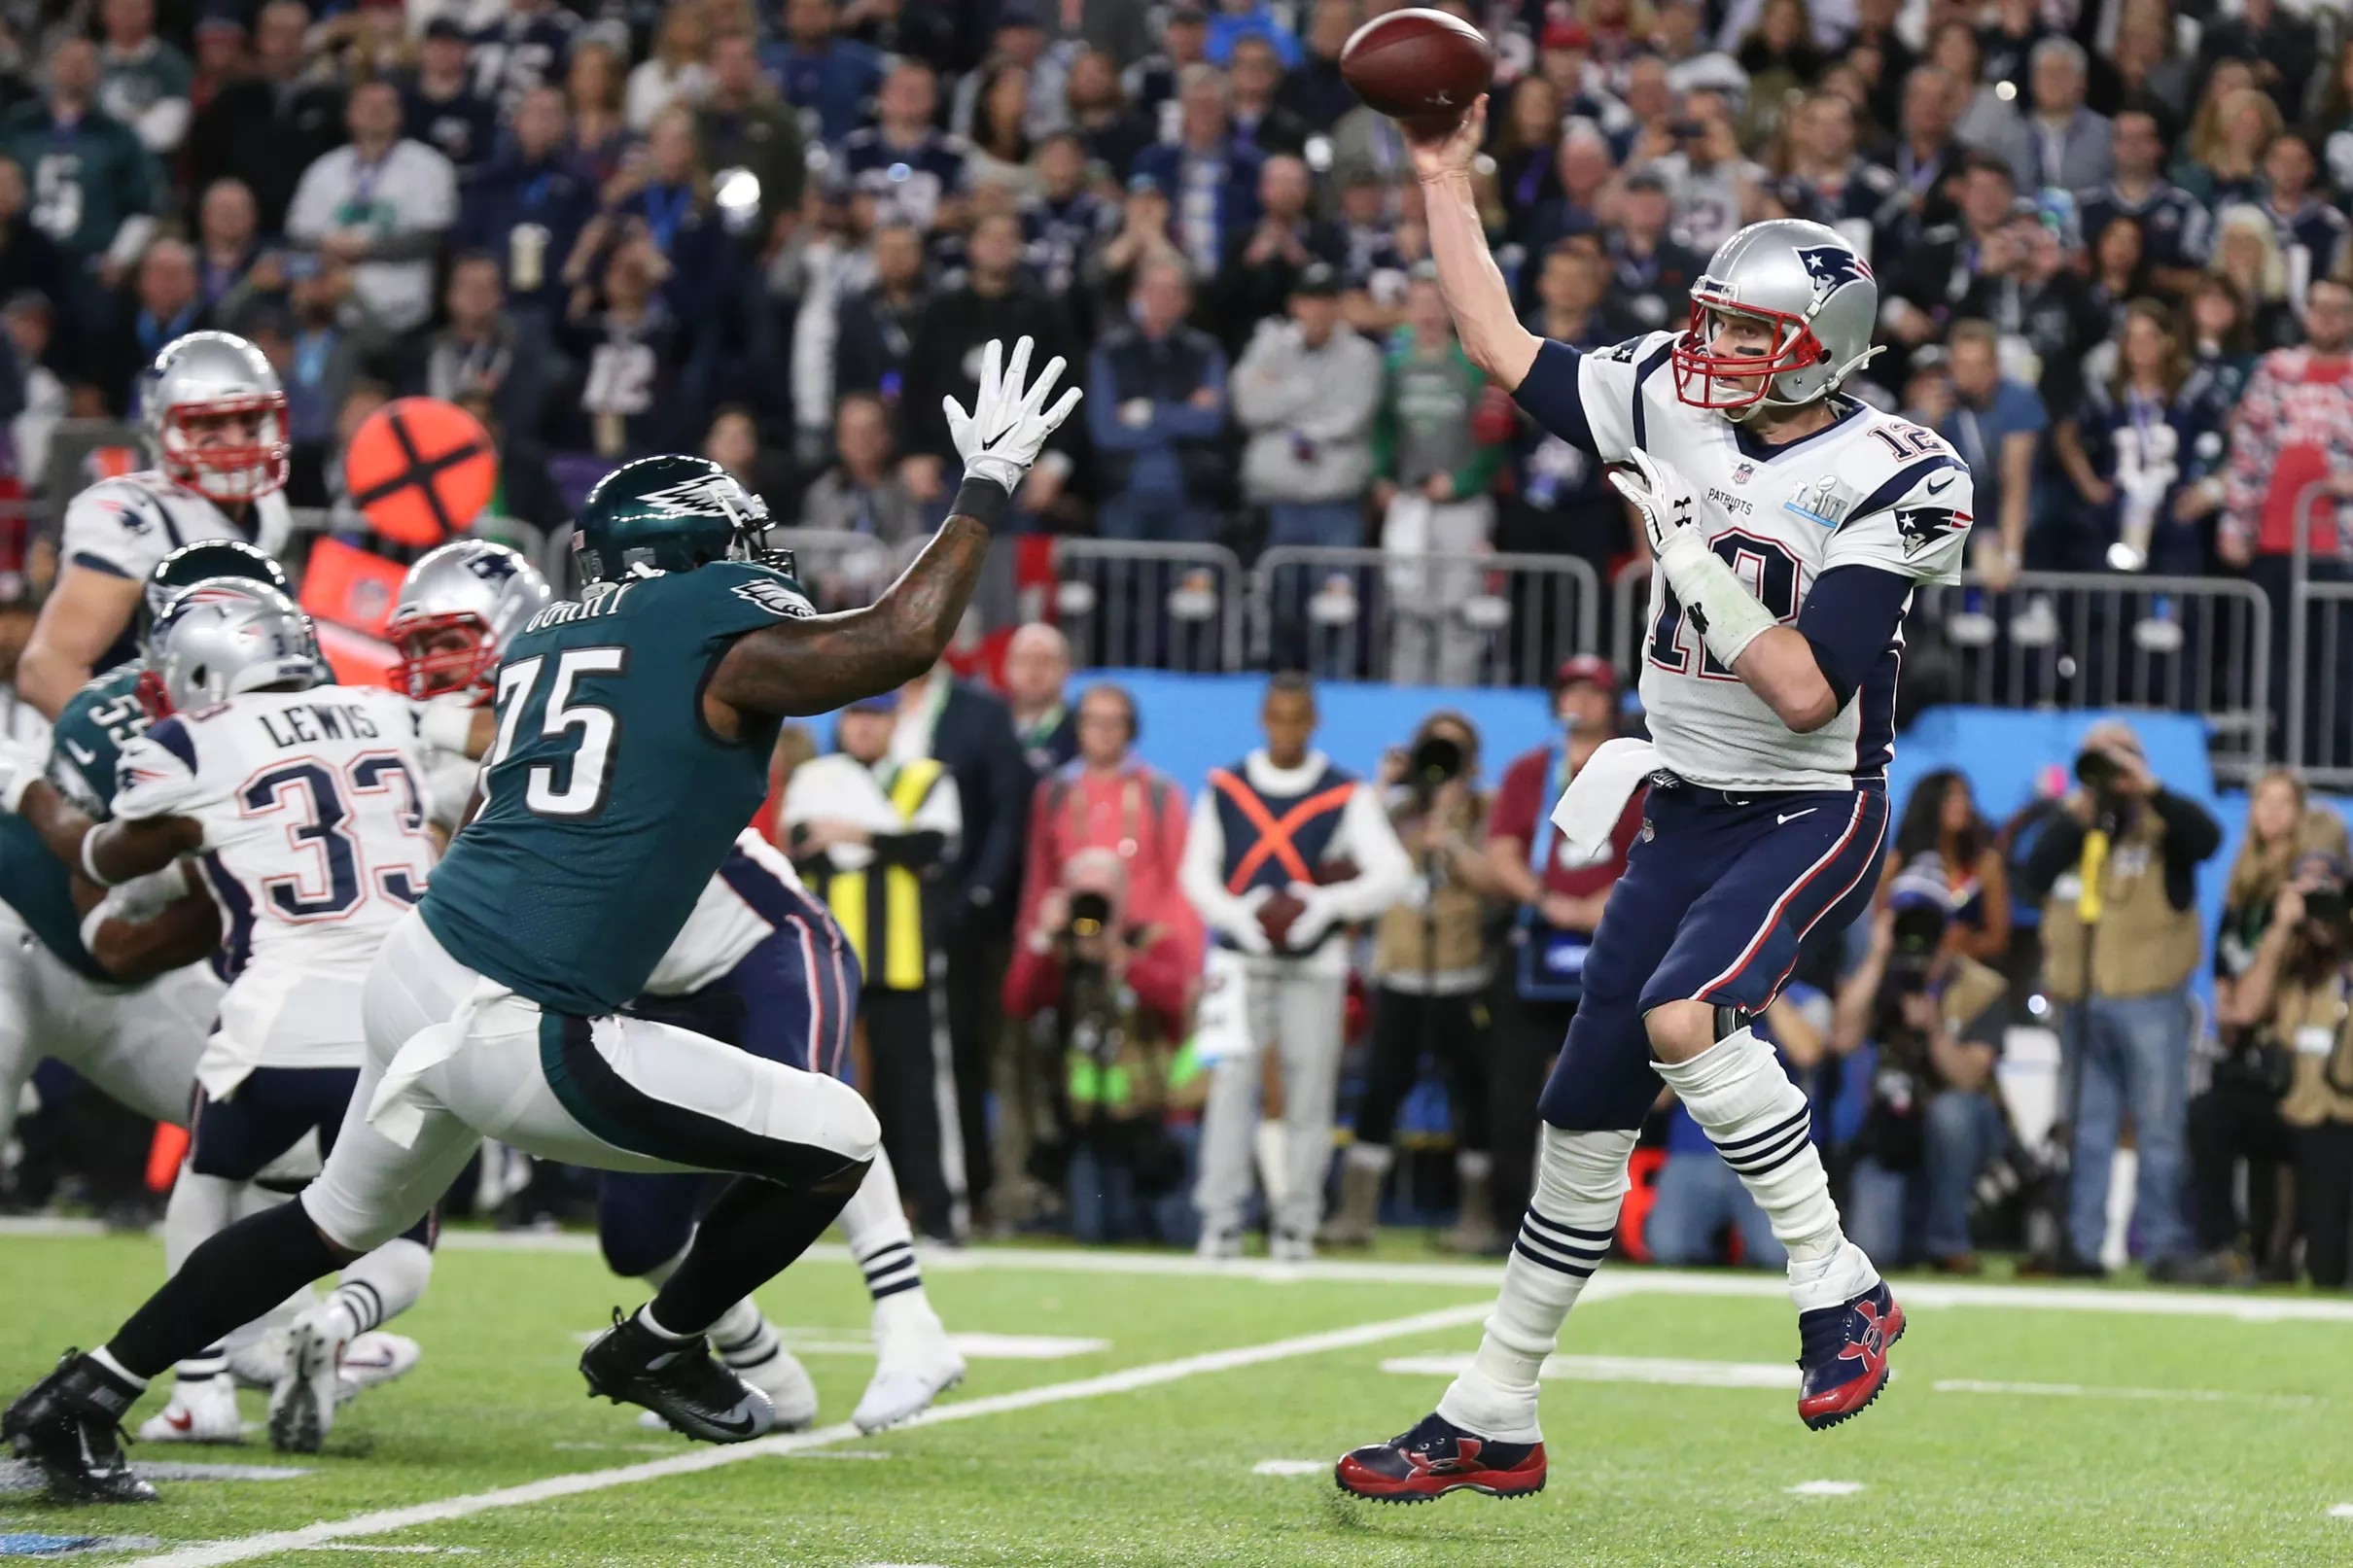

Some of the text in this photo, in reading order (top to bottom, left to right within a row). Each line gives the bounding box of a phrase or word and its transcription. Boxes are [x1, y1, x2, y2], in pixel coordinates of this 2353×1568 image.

[1867, 423, 1946, 462] 12
[1707, 487, 1753, 515] PATRIOTS
[259, 705, 379, 748] LEWIS
[490, 645, 629, 822] 75
[234, 749, 436, 924] 33
